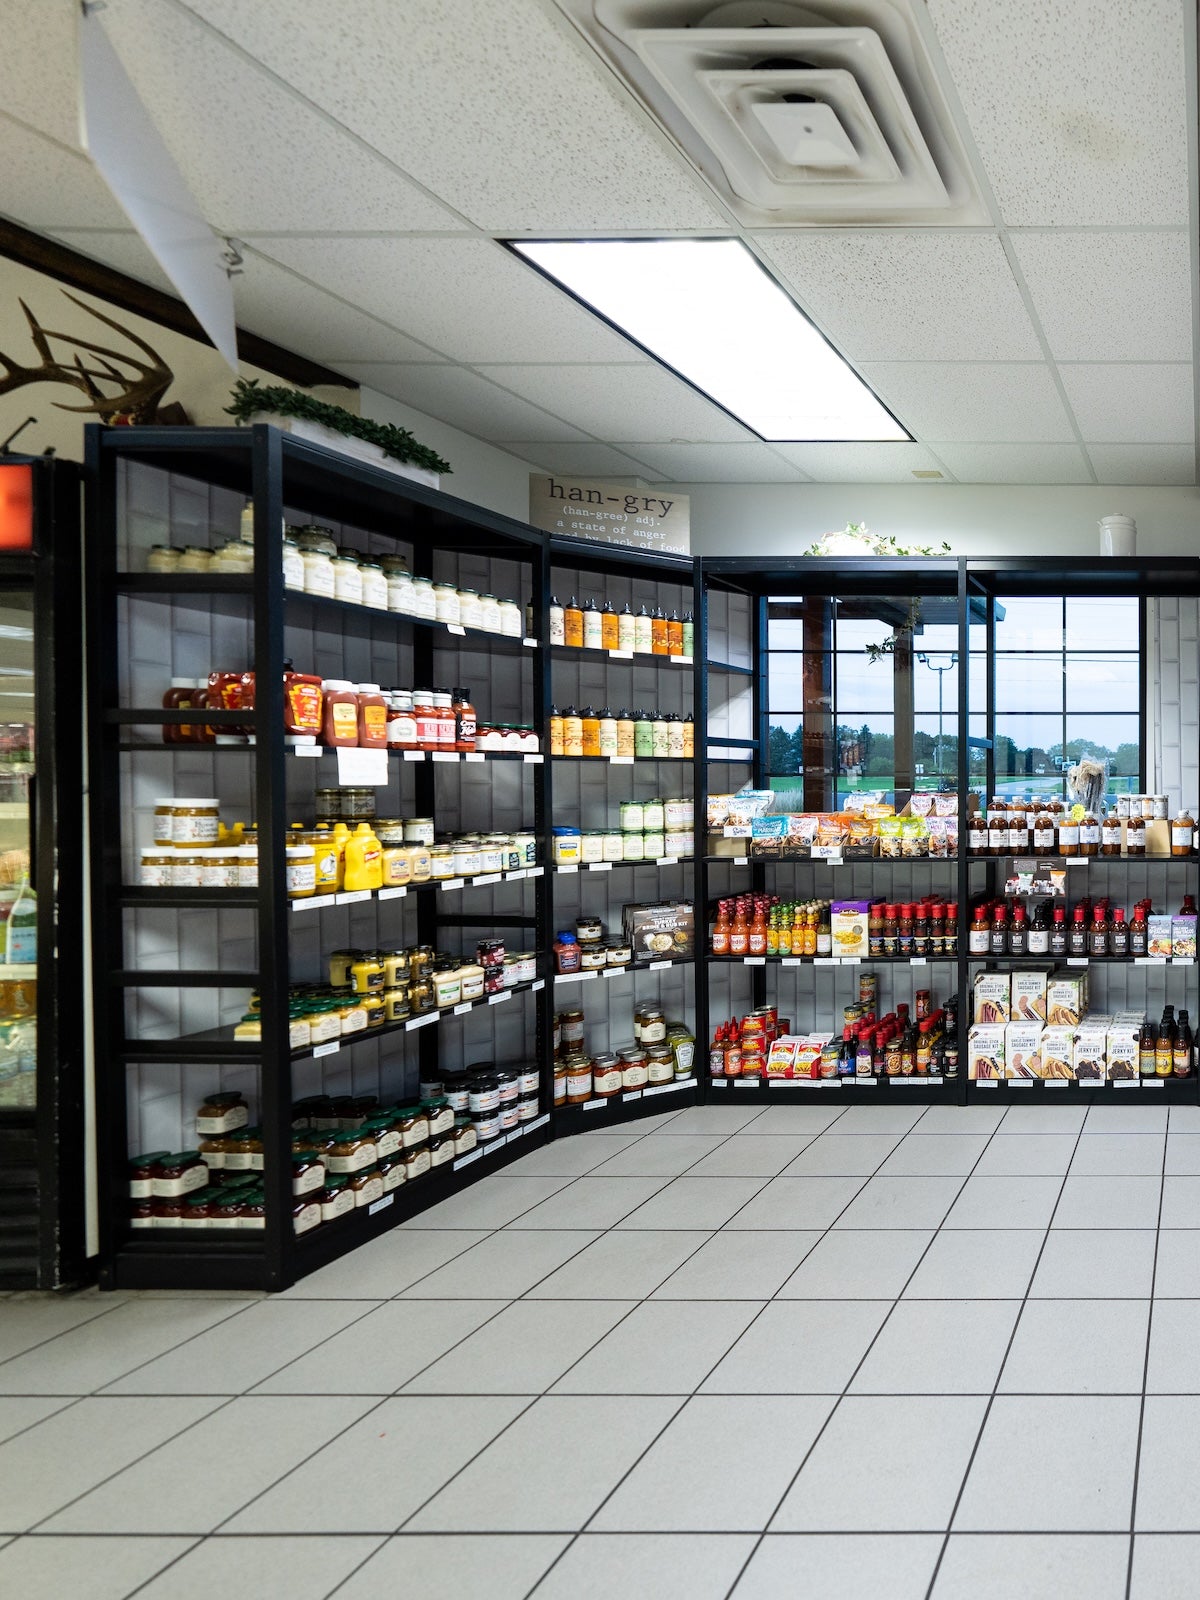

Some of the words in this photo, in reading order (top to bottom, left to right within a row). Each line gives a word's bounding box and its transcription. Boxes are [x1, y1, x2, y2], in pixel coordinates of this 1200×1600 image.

[548, 478, 674, 518] han-gry
[562, 505, 628, 522] (han-gree)
[635, 515, 661, 527] adj.
[571, 521, 606, 532] state
[612, 526, 626, 535] of
[633, 529, 666, 540] anger
[660, 543, 685, 553] food
